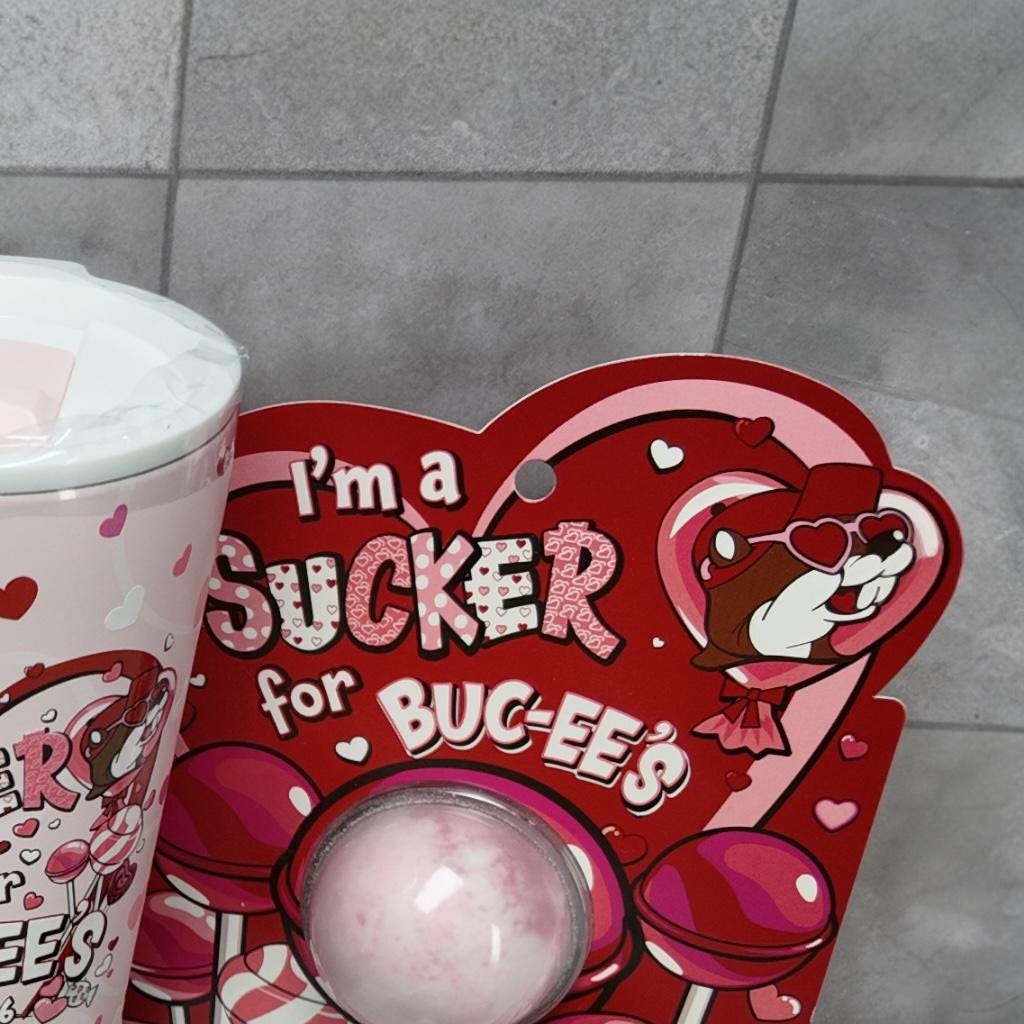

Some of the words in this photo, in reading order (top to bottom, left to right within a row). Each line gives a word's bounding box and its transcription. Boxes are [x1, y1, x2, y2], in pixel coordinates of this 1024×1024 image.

[289, 444, 404, 521] I'm
[419, 448, 467, 510] a
[204, 520, 626, 662] SUCKER
[257, 664, 363, 737] for
[376, 676, 692, 816] BUC-EE'S
